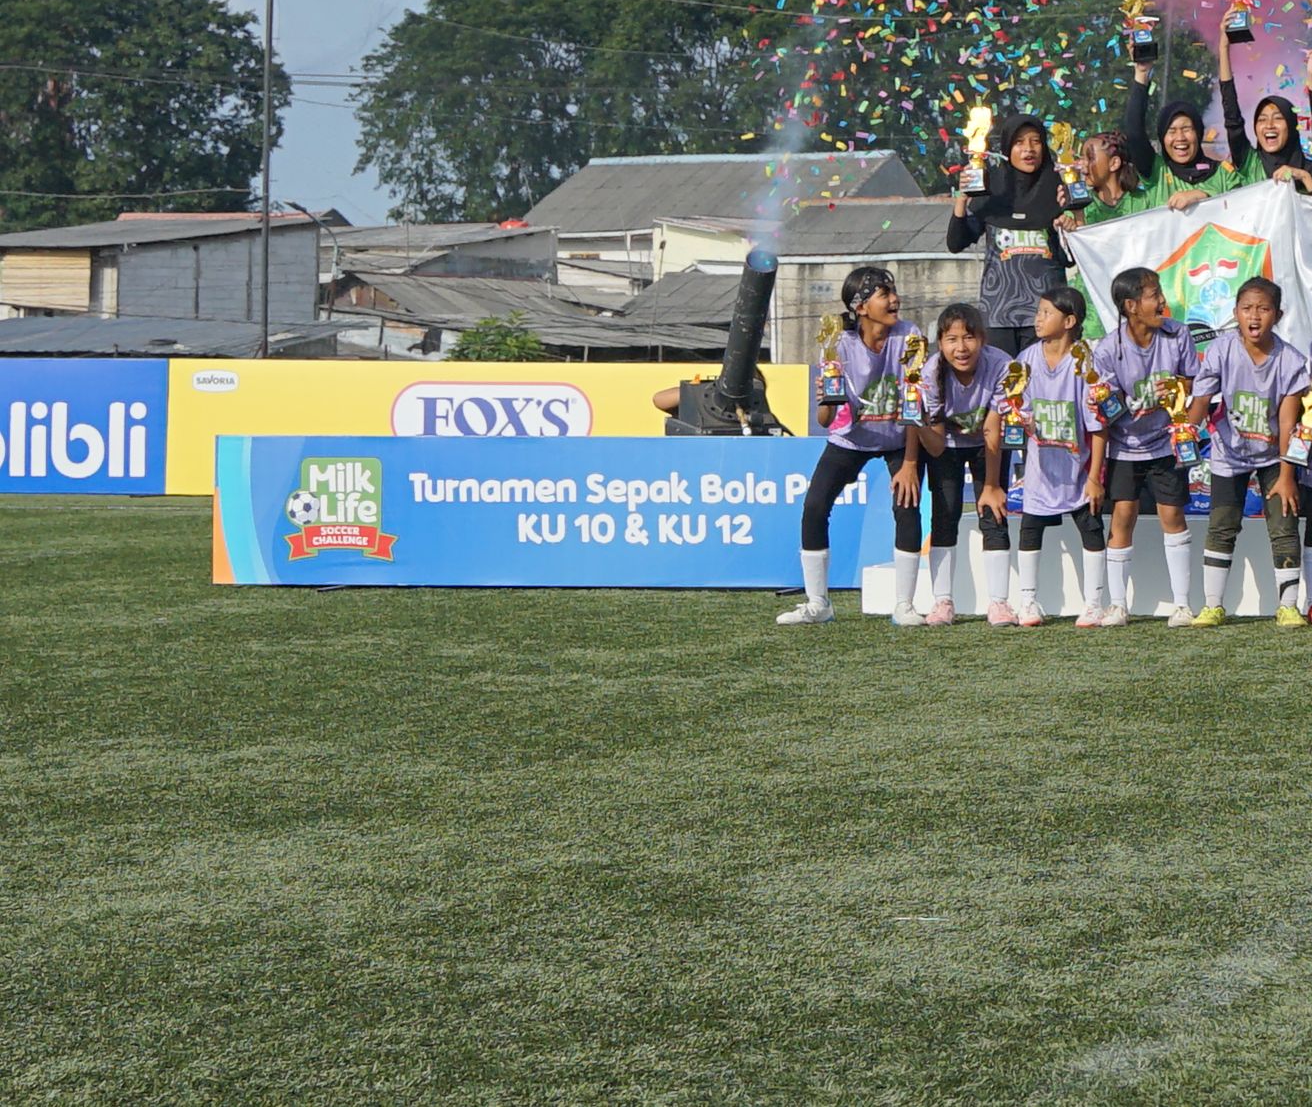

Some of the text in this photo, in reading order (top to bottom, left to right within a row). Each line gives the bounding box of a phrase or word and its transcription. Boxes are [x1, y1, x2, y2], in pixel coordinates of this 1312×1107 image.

[1013, 228, 1048, 248] Life
[196, 374, 236, 386] SAVORIA
[416, 396, 570, 437] FOX'S
[1033, 402, 1073, 423] Milk
[0, 401, 147, 479] libli
[1040, 421, 1074, 441] Life
[309, 461, 375, 493] Milk
[409, 471, 868, 511] Turnamen Sepak Bola Pri
[320, 492, 377, 523] Life
[312, 535, 369, 547] CHALLENGE
[320, 526, 361, 536] SOCCER
[518, 512, 753, 546] KU 10 & KU 12
